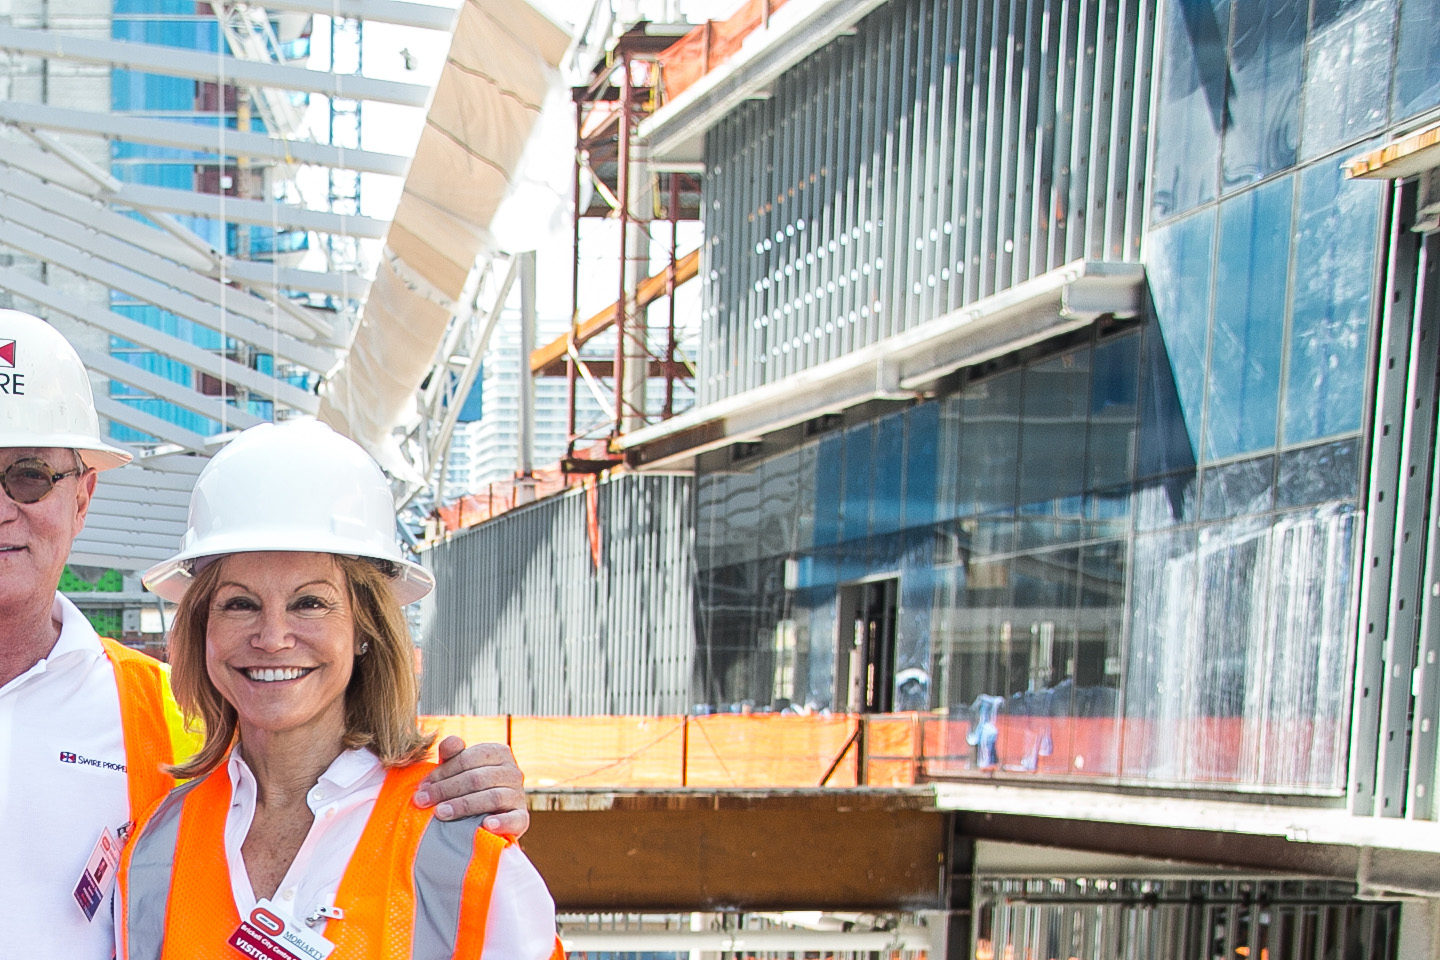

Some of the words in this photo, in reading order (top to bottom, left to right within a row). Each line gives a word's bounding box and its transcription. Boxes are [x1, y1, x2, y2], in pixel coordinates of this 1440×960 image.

[78, 755, 102, 768] SWIRE
[102, 761, 128, 774] PROPE
[240, 924, 263, 941] Brickell
[261, 938, 274, 949] City
[284, 930, 325, 960] MORIARTY
